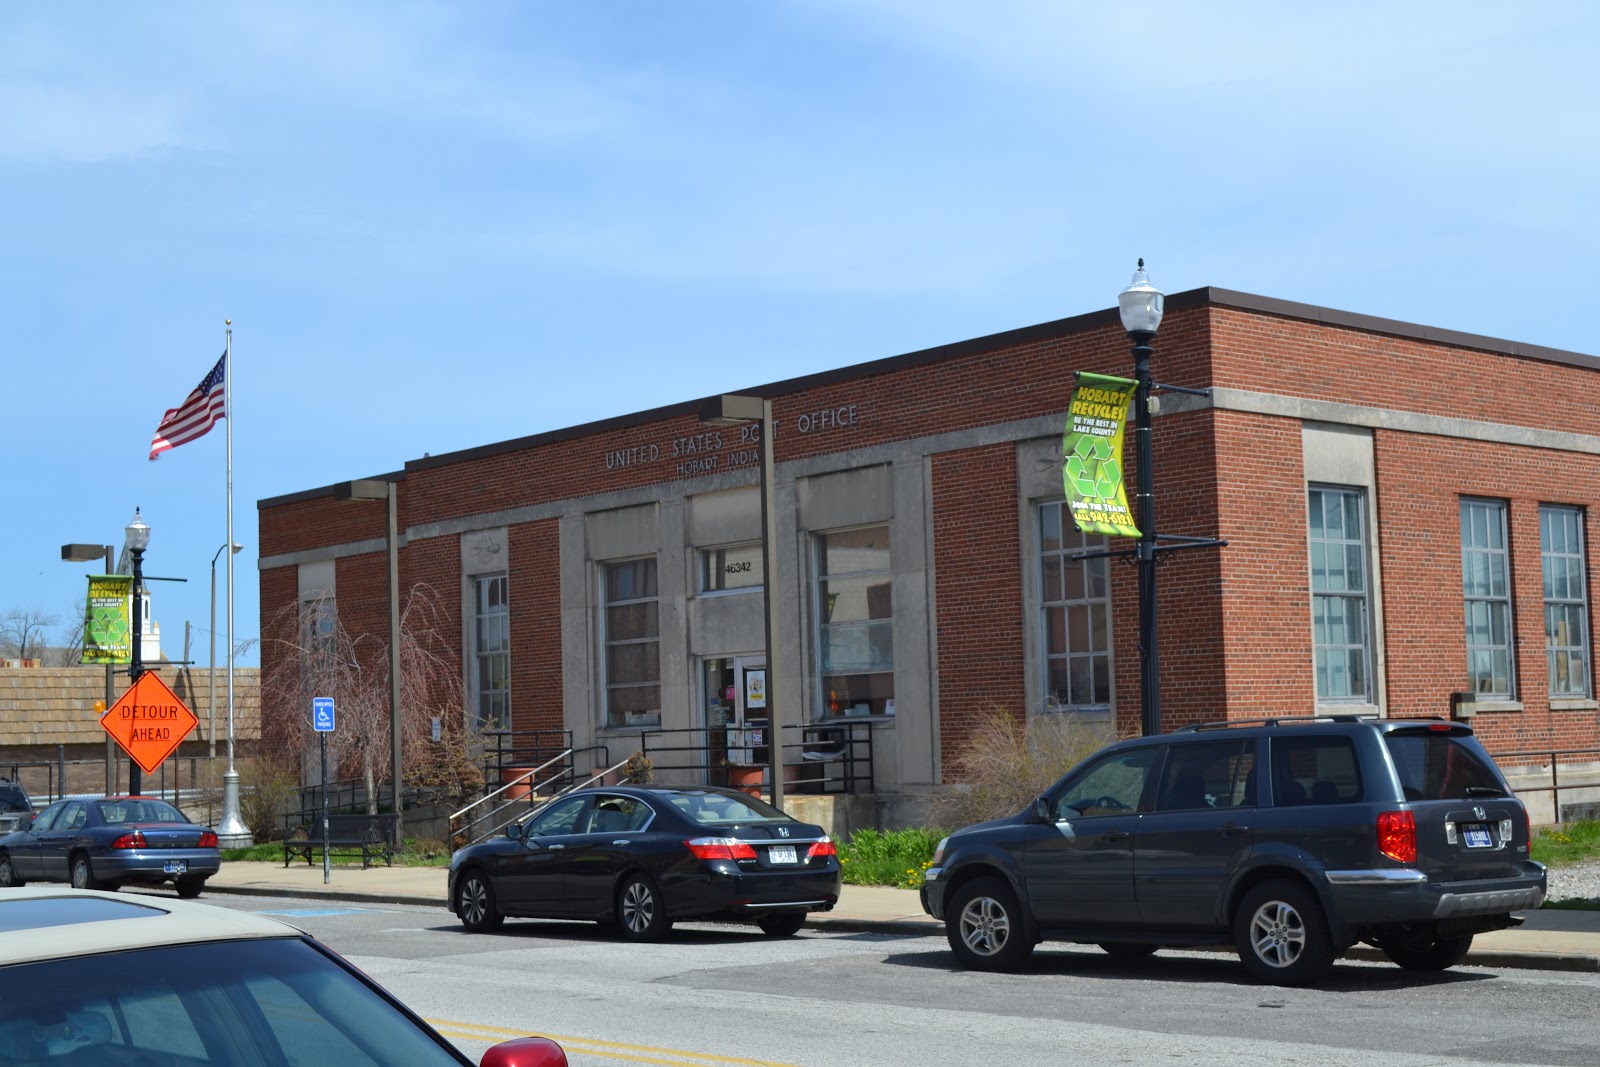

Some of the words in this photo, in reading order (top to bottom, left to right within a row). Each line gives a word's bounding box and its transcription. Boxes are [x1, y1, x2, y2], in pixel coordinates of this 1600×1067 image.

[1077, 386, 1127, 405] HOBART
[1072, 400, 1124, 420] RECYCLES
[1074, 416, 1082, 424] BE
[1083, 417, 1095, 426] THE
[1096, 419, 1110, 428] BEST
[1110, 421, 1118, 429] IN
[606, 444, 659, 470] UNITED
[673, 432, 722, 457] STATES
[741, 420, 779, 445] POT
[798, 405, 858, 433] OFFICE
[1073, 425, 1090, 433] LAKE
[1091, 427, 1116, 437] COUNTY
[676, 456, 718, 475] HOBART
[727, 450, 760, 467] INDIA
[1072, 500, 1088, 509] JOIN
[1103, 503, 1127, 513] TEAM!
[1074, 512, 1091, 521] CALL
[1090, 511, 1133, 526] 942-6121
[725, 561, 751, 574] 46342
[91, 582, 127, 590] HOBART
[121, 705, 178, 719] DETOUR
[132, 727, 170, 740] AHEAD
